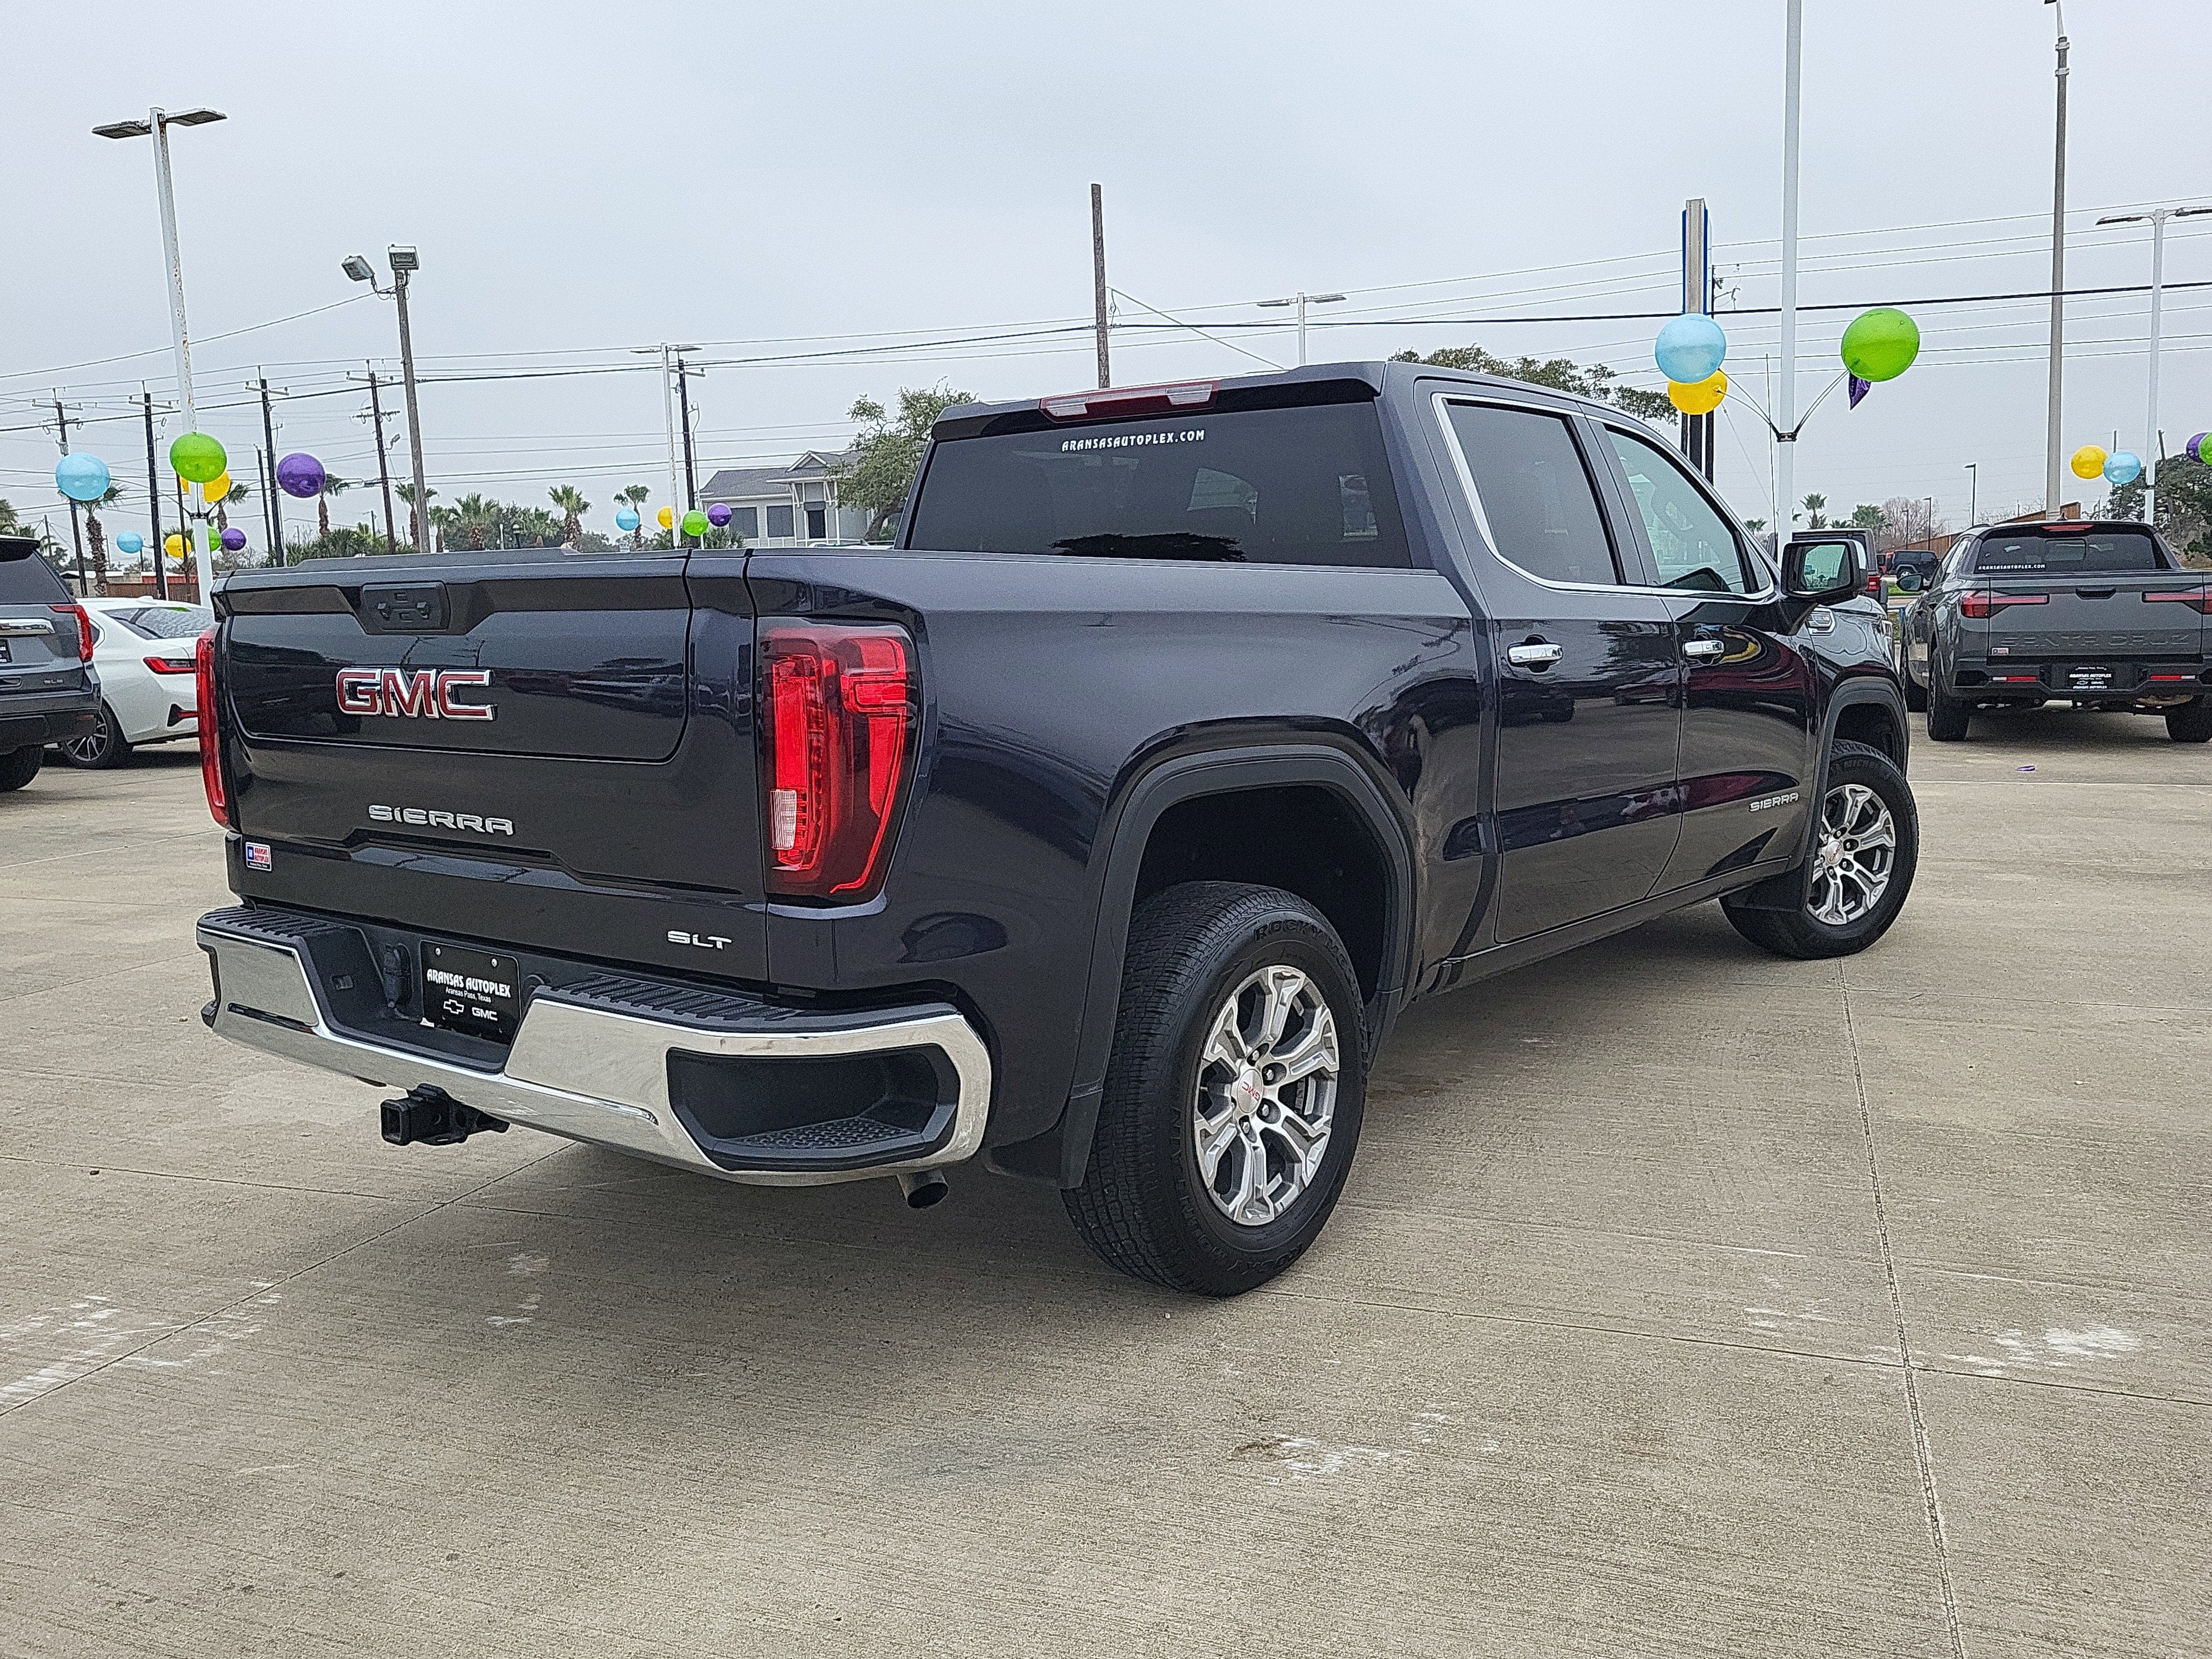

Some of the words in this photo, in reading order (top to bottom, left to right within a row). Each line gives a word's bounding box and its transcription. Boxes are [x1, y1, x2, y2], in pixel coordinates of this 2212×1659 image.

[1062, 430, 1206, 452] ARANSASAUTOPLEX.COM
[2000, 635, 2099, 646] SANTA
[2107, 634, 2189, 646] CRUZ
[336, 667, 495, 721] GMC
[1749, 792, 1798, 812] SIERRA
[368, 805, 514, 836] SIERRA
[667, 931, 732, 950] SLT
[1254, 919, 1323, 941] ROCKY
[426, 968, 464, 988] ARANSAS
[466, 977, 511, 998] AUTOPLEX
[445, 987, 463, 997] Aransas
[478, 993, 492, 1003] Texas
[472, 1006, 498, 1021] GMC
[1241, 1081, 1261, 1102] GMC
